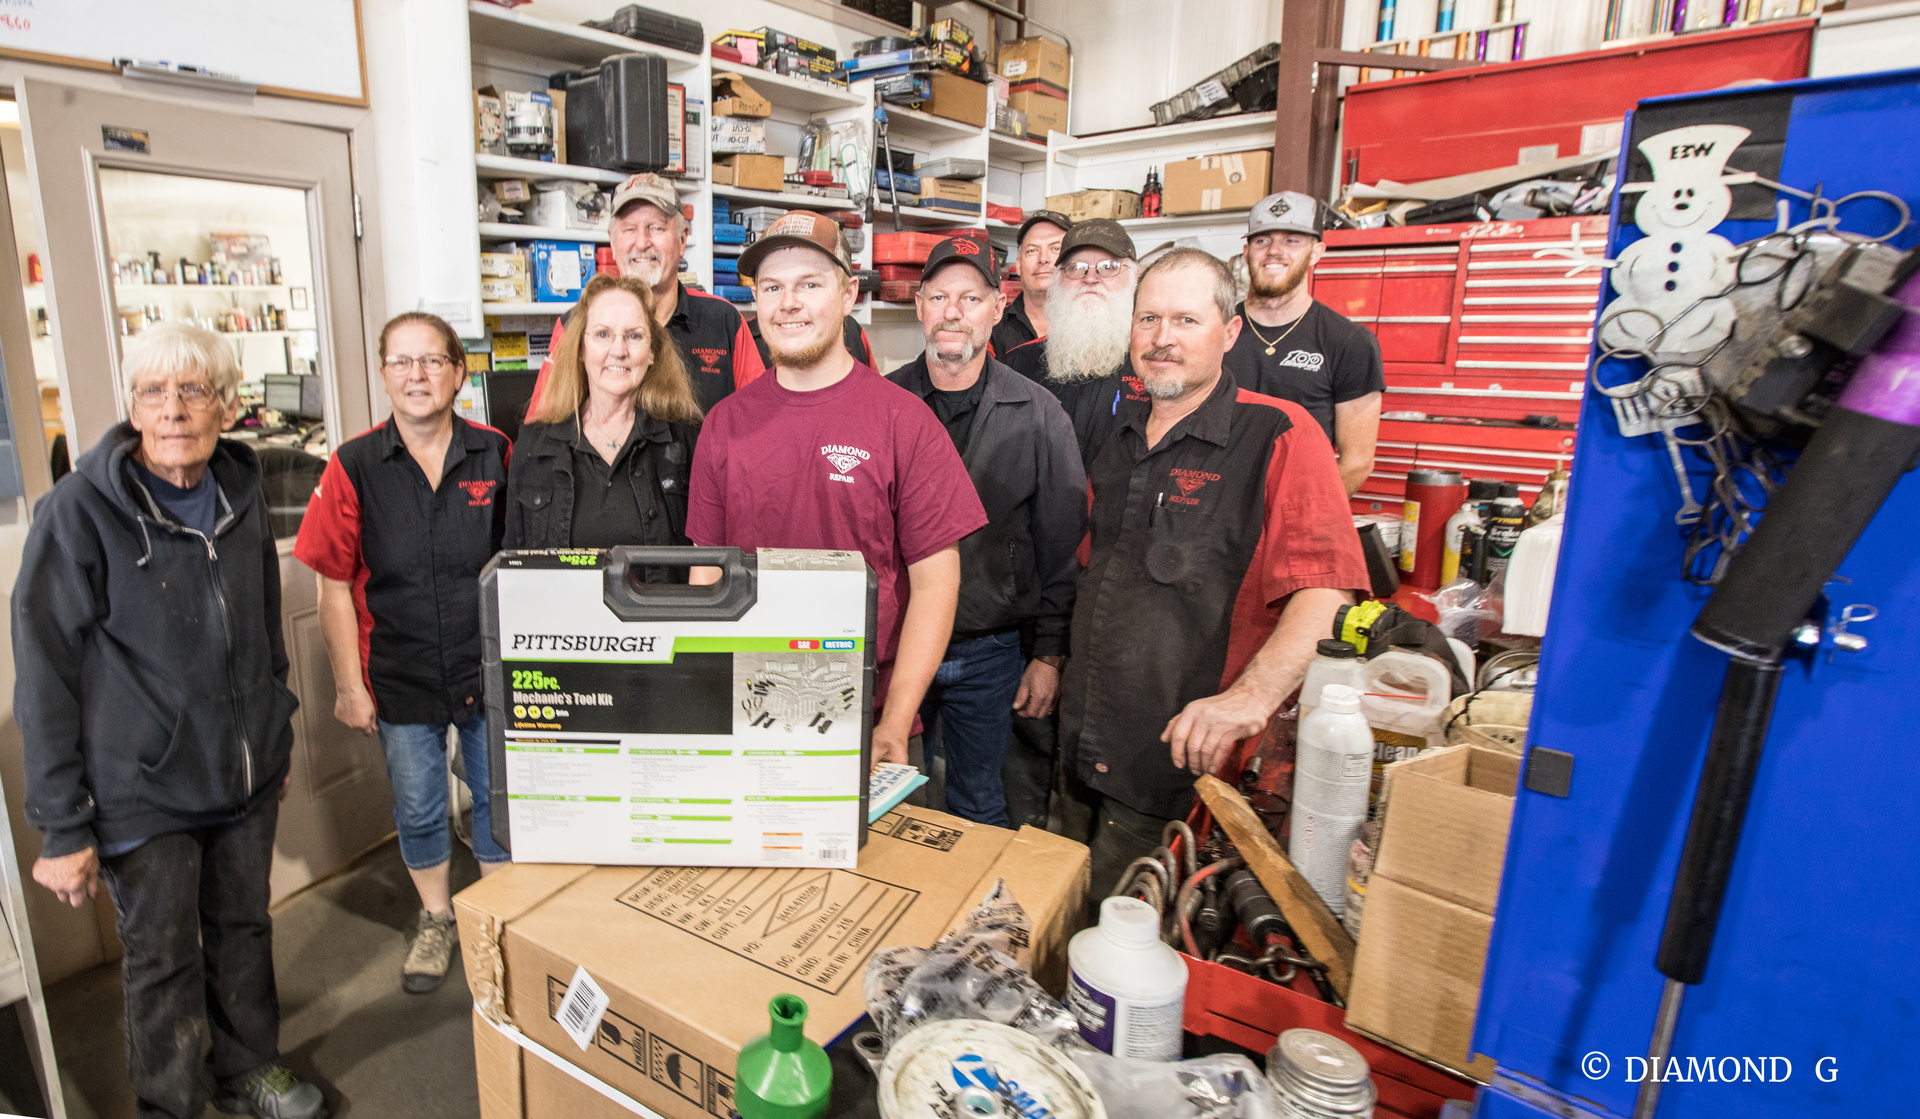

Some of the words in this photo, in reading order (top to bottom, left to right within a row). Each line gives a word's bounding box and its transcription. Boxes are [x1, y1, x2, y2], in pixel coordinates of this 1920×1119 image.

[1460, 222, 1510, 239] 323
[691, 347, 728, 356] DIAMOND
[701, 366, 721, 374] REPAIR
[1125, 394, 1150, 402] REPAIR
[821, 444, 871, 460] DIAMOND
[829, 473, 855, 484] REPAIR
[1169, 468, 1221, 482] DIAMOND
[458, 480, 497, 489] DIAMOND
[1169, 495, 1200, 506] REPAIR
[511, 633, 657, 654] PITTSBURGH
[797, 640, 811, 650] SAE
[824, 640, 853, 650] METRIC
[512, 690, 573, 706] Mechanic's
[573, 692, 597, 706] Tool
[597, 693, 614, 707] Kit
[627, 884, 655, 904] SKU#:
[644, 891, 671, 911] DESC:
[660, 902, 683, 918] QTY:
[687, 882, 706, 897] SET
[675, 909, 698, 926] NW:
[693, 917, 716, 933] GW:
[775, 952, 797, 969] DC:
[791, 922, 823, 951] MORENO
[817, 901, 843, 928] VALLEY
[741, 938, 764, 955] PO:
[816, 963, 843, 986] MADE
[833, 951, 852, 967] IN:
[847, 926, 873, 949] CHINA
[632, 1028, 645, 1067] FRAGILE
